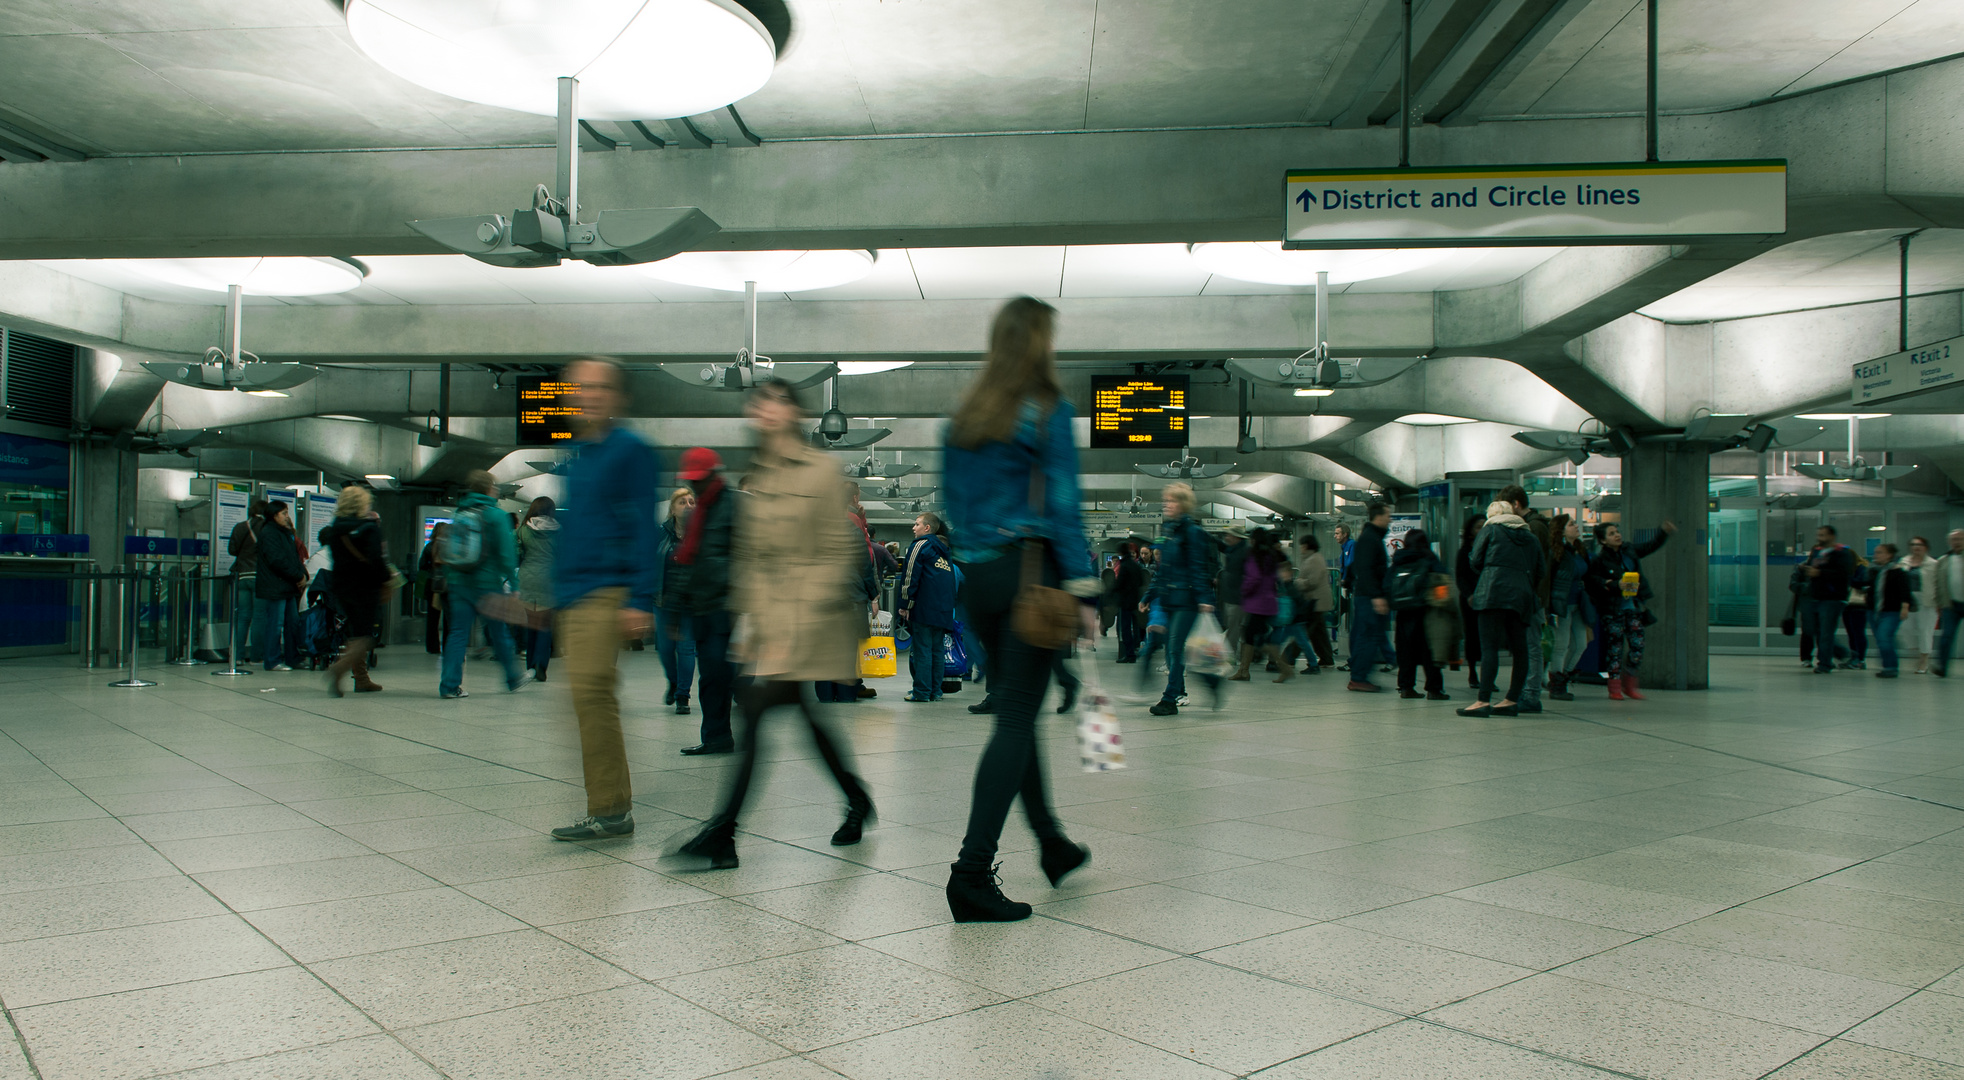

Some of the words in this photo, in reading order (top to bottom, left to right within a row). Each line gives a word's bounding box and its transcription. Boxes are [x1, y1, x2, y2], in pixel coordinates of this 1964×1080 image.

[1322, 188, 1421, 210] District
[1430, 187, 1478, 209] and
[1488, 185, 1566, 208] Circle
[1577, 184, 1641, 206] lines
[1920, 348, 1941, 364] Exit
[1944, 345, 1950, 358] 2
[1863, 364, 1881, 378] Exit
[1883, 362, 1888, 374] 1
[1920, 367, 1942, 376] Victoria
[1920, 372, 1955, 385] Embankment
[934, 561, 951, 572] adidas
